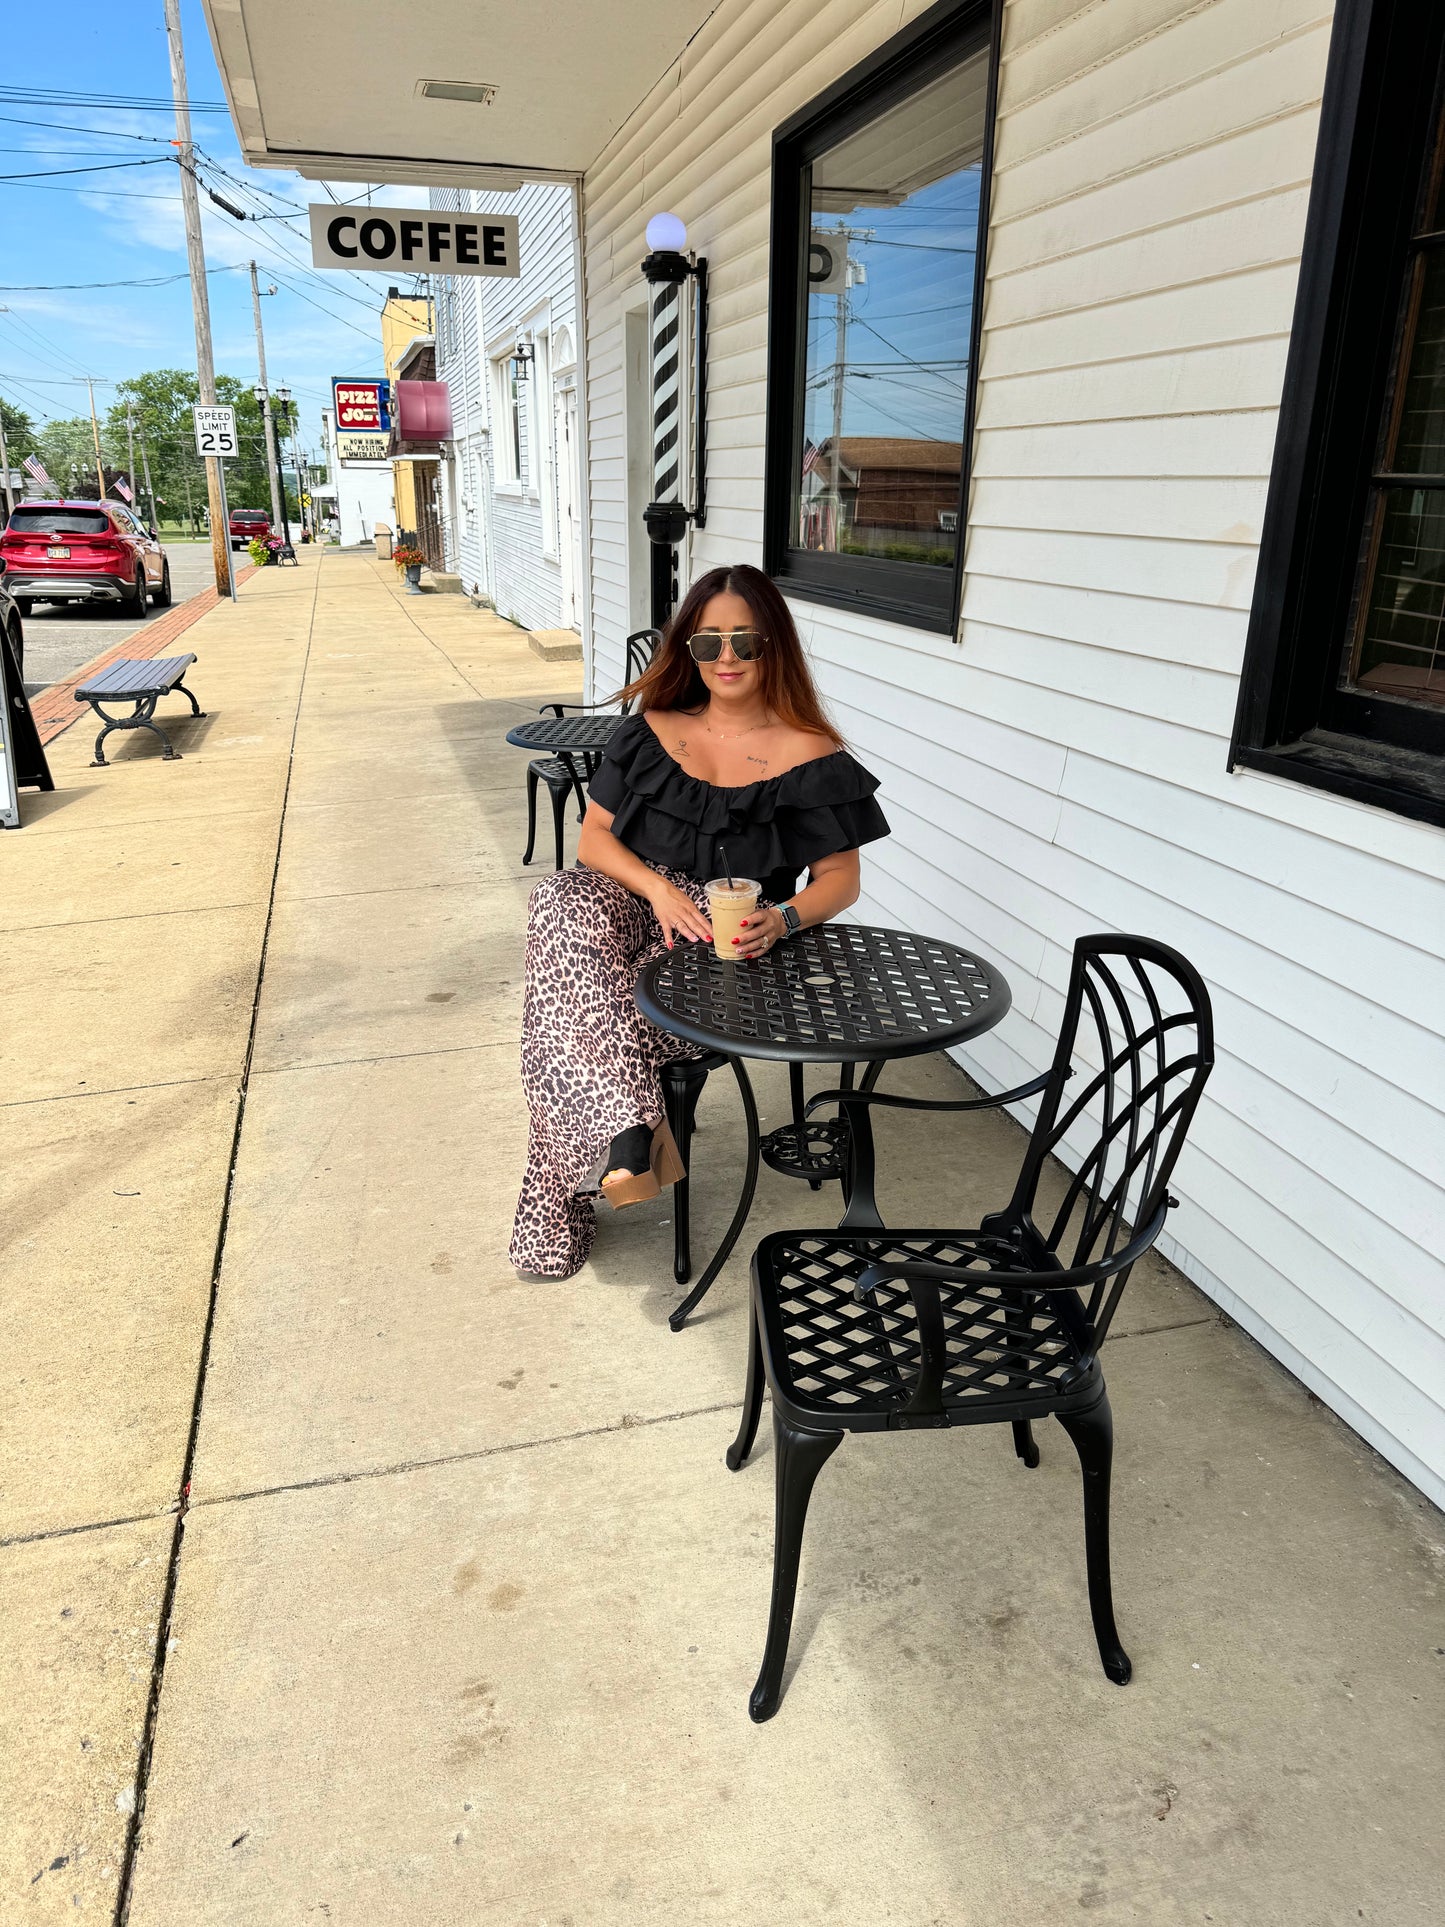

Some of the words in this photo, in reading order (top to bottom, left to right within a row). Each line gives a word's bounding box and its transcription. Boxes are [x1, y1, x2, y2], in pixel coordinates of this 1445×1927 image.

[327, 216, 507, 266] COFFEE
[338, 391, 378, 404] PIZZ
[198, 412, 230, 420] SPEED
[201, 433, 233, 451] 25
